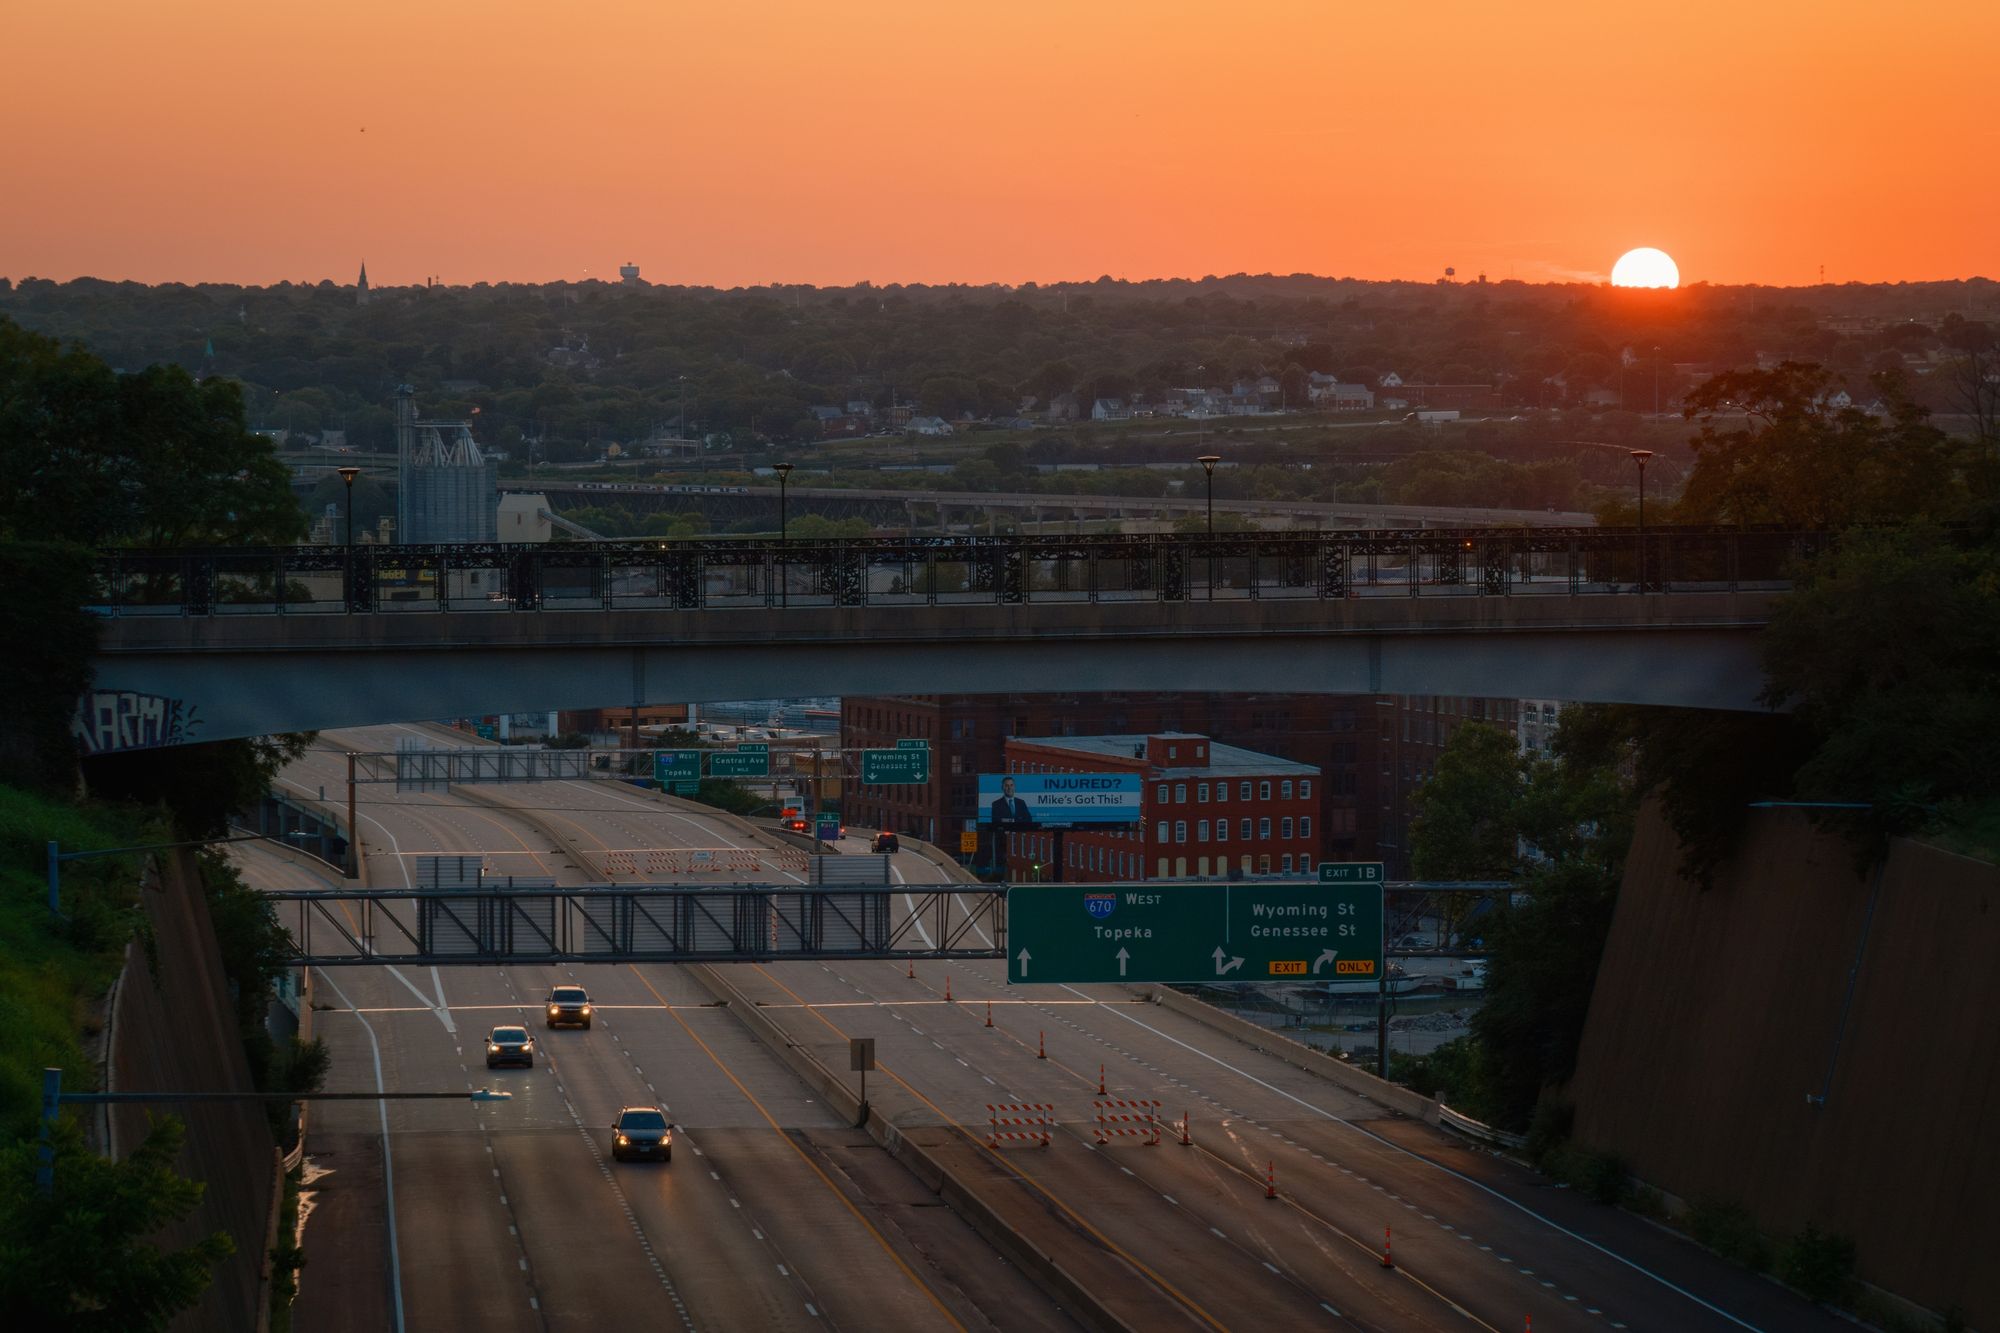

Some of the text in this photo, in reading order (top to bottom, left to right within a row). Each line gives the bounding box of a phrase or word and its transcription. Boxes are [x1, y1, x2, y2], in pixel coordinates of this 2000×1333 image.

[871, 753, 908, 761] Wyoming
[1044, 778, 1122, 789] INJURED?
[1037, 794, 1123, 805] Mike's Got This!
[1326, 867, 1376, 880] EXIT 1B
[1126, 893, 1162, 905] WEST
[1089, 900, 1112, 913] 670
[1252, 903, 1356, 919] Wyoming St
[1094, 926, 1153, 941] Topeka
[1251, 925, 1357, 938] Genessee St
[1274, 961, 1372, 973] EXIT ONLY
